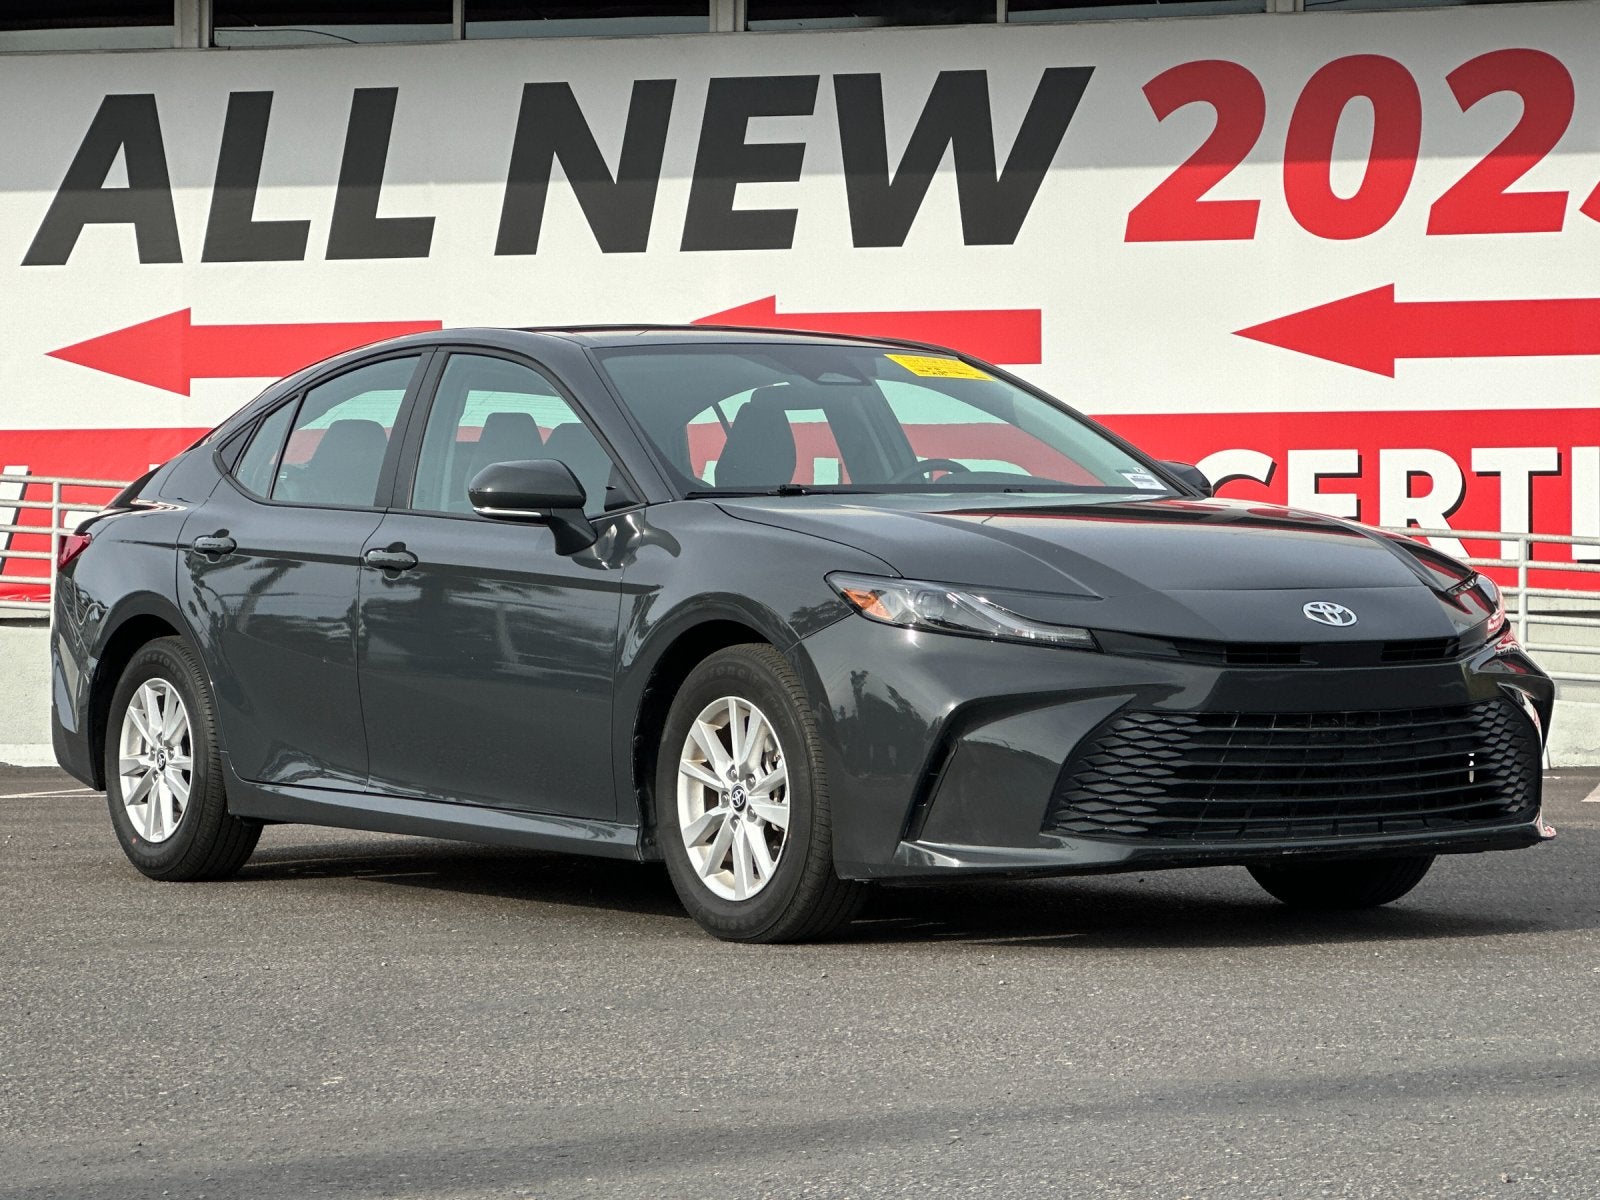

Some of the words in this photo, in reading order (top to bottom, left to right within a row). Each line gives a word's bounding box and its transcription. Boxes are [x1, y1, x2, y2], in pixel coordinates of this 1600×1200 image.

[22, 87, 436, 266] ALL
[495, 66, 1095, 257] NEW
[1125, 48, 1600, 242] 202
